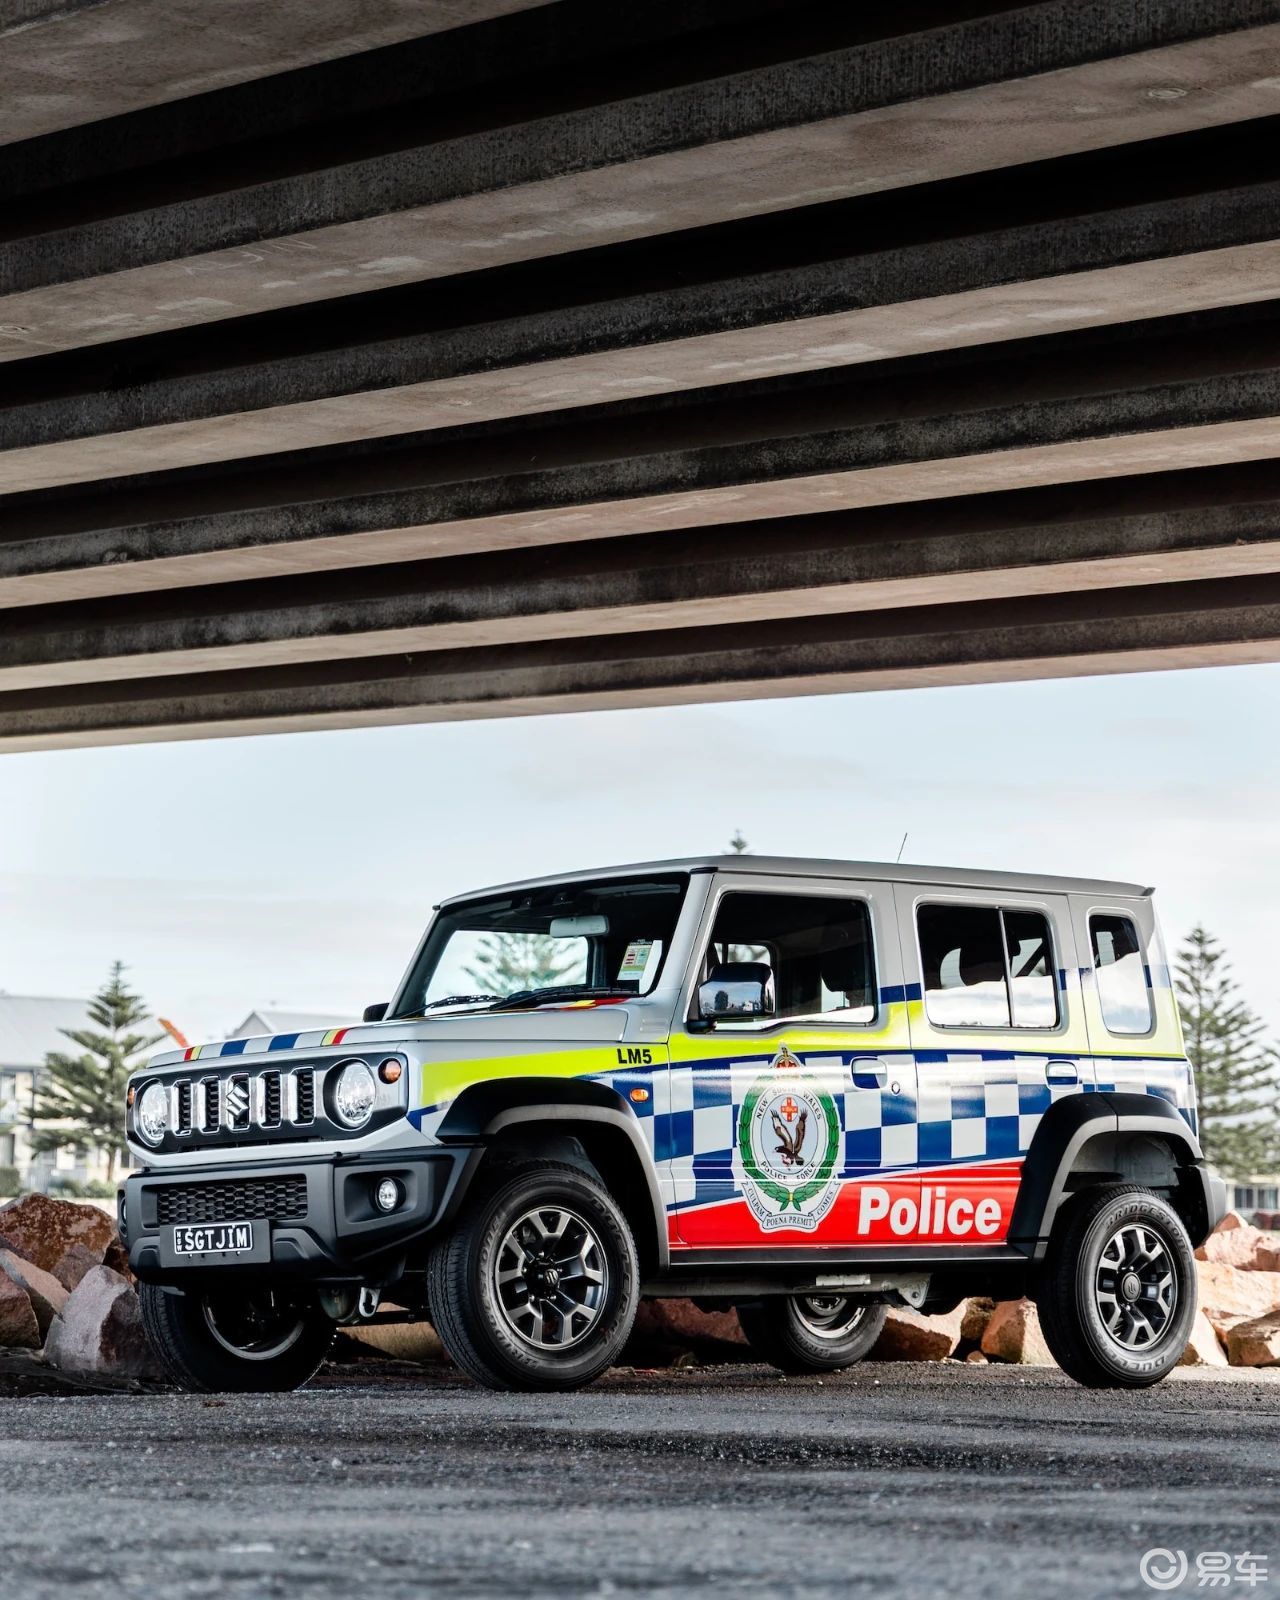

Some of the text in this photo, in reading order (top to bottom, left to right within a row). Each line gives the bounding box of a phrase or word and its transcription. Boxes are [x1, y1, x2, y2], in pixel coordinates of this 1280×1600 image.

[617, 1048, 652, 1064] LM5
[756, 1097, 768, 1120] NEW
[803, 1090, 821, 1120] WALES
[760, 1161, 816, 1180] POLICE FORCE
[747, 1188, 833, 1227] CULPAM POENA PREMIT COMES
[857, 1186, 1002, 1235] Police
